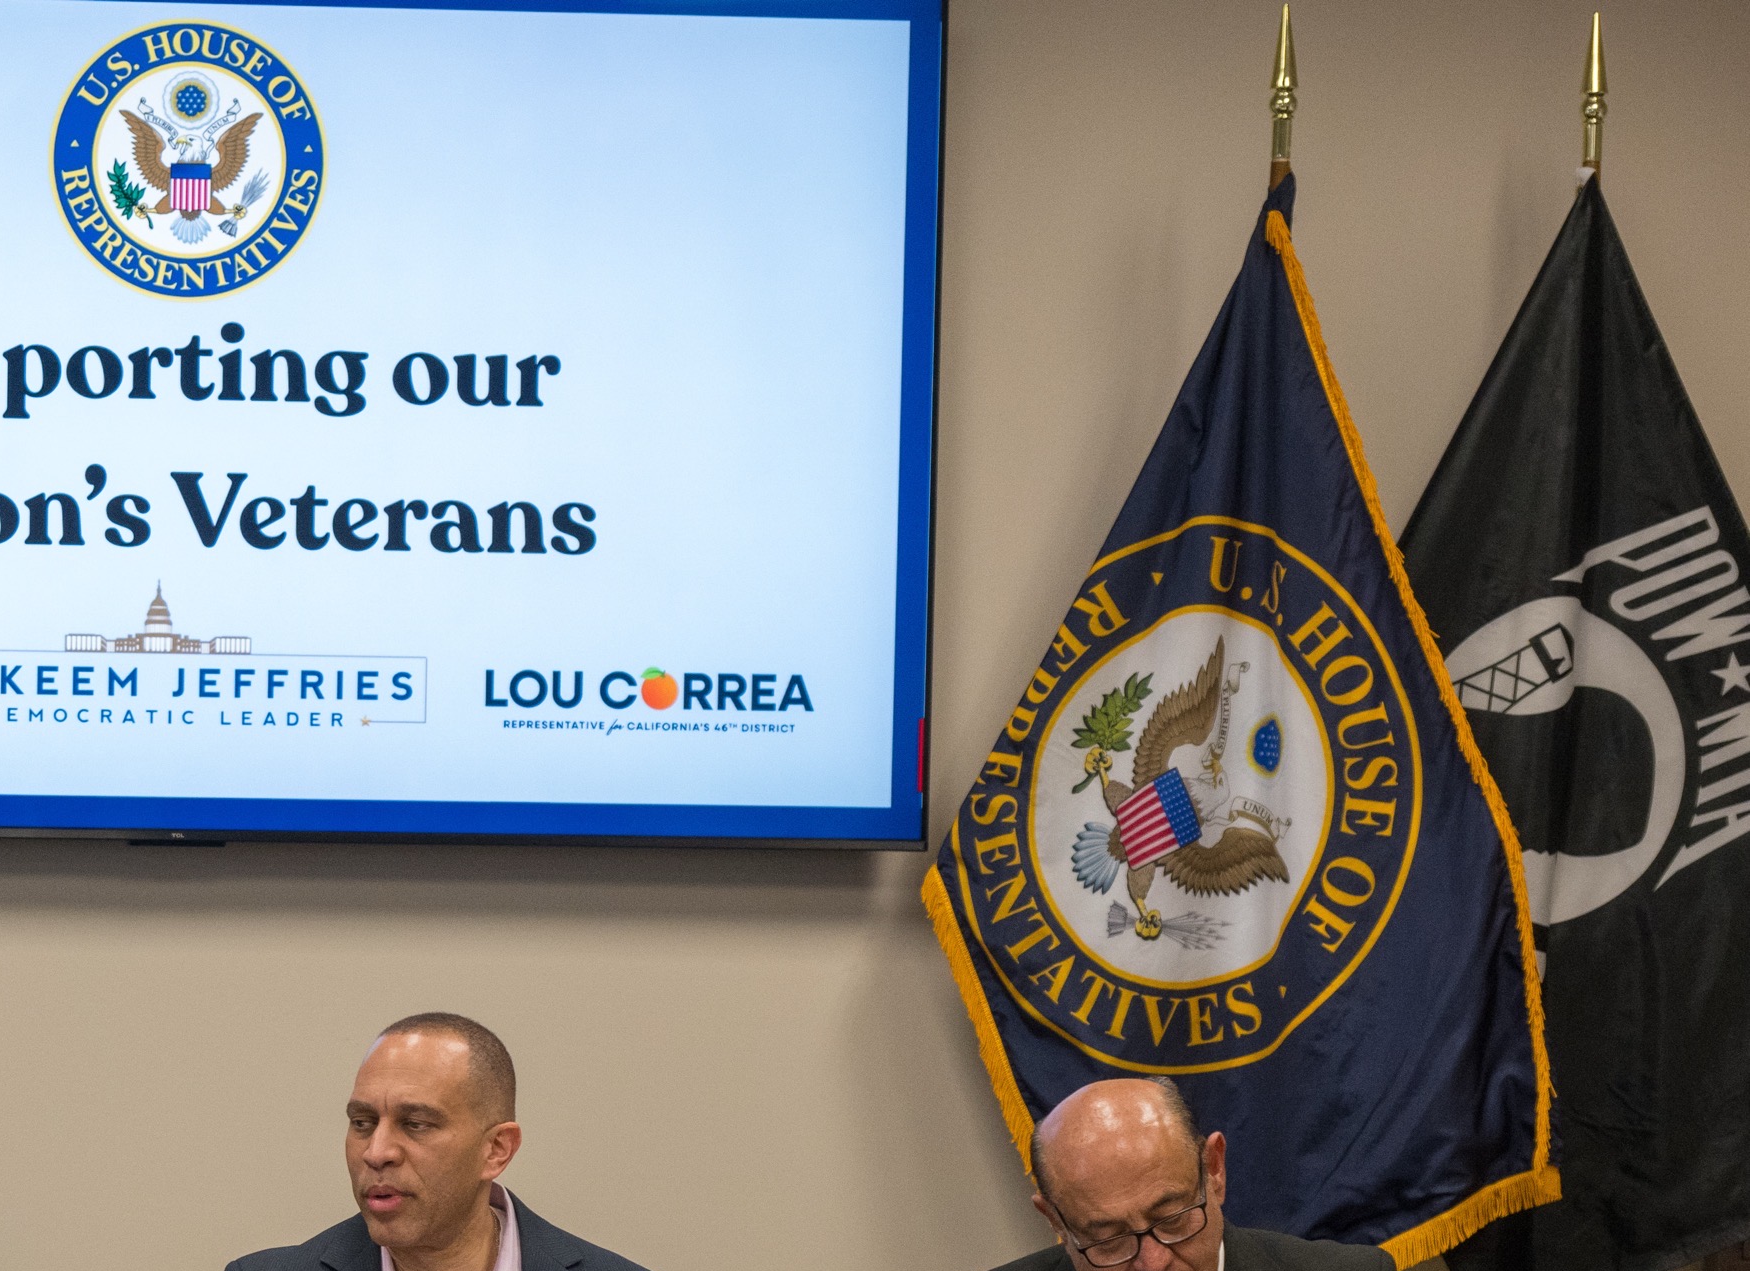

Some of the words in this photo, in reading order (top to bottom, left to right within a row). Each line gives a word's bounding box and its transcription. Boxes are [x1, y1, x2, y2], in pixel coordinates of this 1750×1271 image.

[77, 51, 140, 107] U.S.
[142, 28, 273, 82] HOUSE
[267, 75, 312, 121] OF
[207, 117, 230, 134] UNUM
[61, 165, 319, 290] REPRESENTATIVES
[392, 351, 562, 407] our
[170, 471, 598, 555] Veterans
[1210, 535, 1287, 627] U.S.
[1550, 505, 1750, 661] POW
[171, 667, 414, 701] JEFFRIES
[220, 711, 345, 727] LEADER
[485, 669, 583, 709] LOU
[1287, 600, 1399, 838] HOUSE
[503, 720, 605, 731] REPRESENTATIVE
[607, 719, 624, 736] for
[741, 723, 796, 734] DISTRICT
[971, 579, 1264, 1048] REPRESENTATIVES
[1243, 801, 1274, 826] UNUM
[1303, 857, 1376, 954] OF
